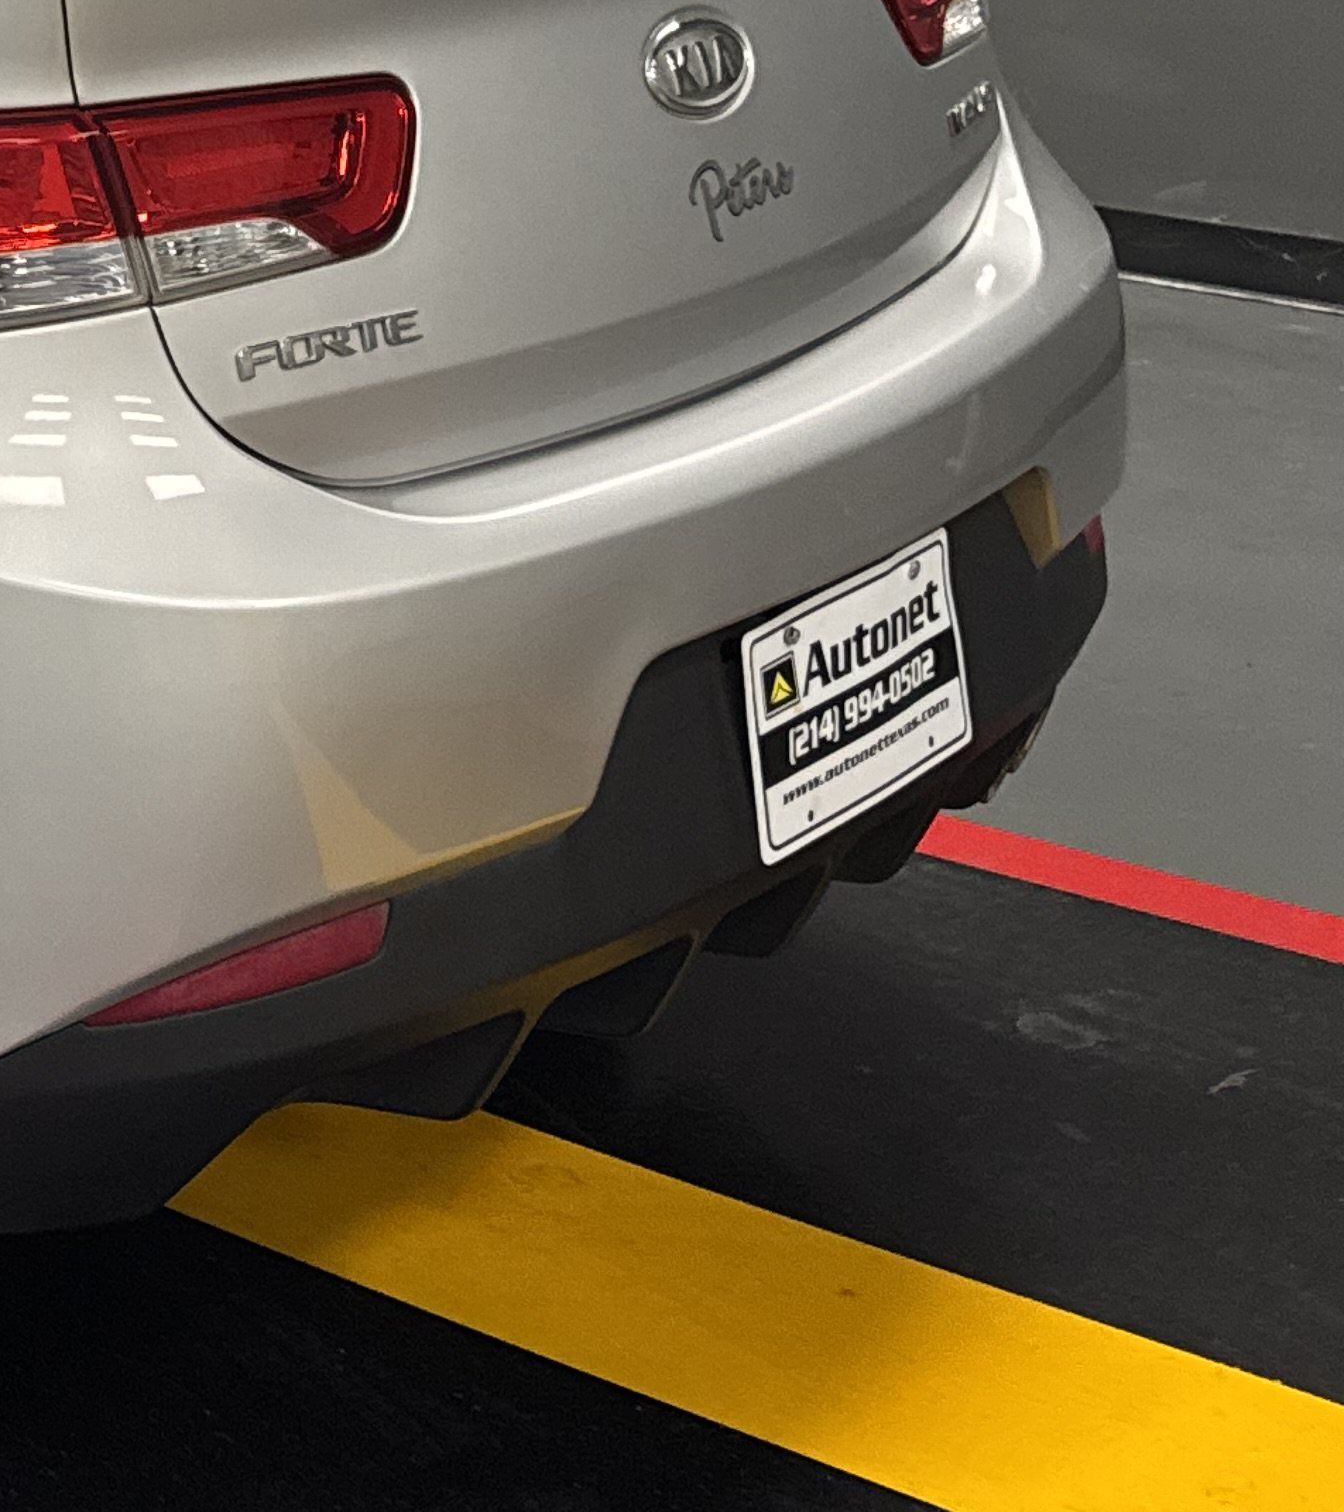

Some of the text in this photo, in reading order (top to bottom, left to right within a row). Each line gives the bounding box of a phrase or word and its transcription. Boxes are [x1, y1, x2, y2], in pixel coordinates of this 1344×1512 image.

[665, 34, 737, 96] KIA
[234, 308, 424, 382] FORTE
[802, 580, 940, 697] Autonet
[783, 697, 950, 805] www.autonettexas.com
[788, 647, 936, 766] (214) 994-0502
